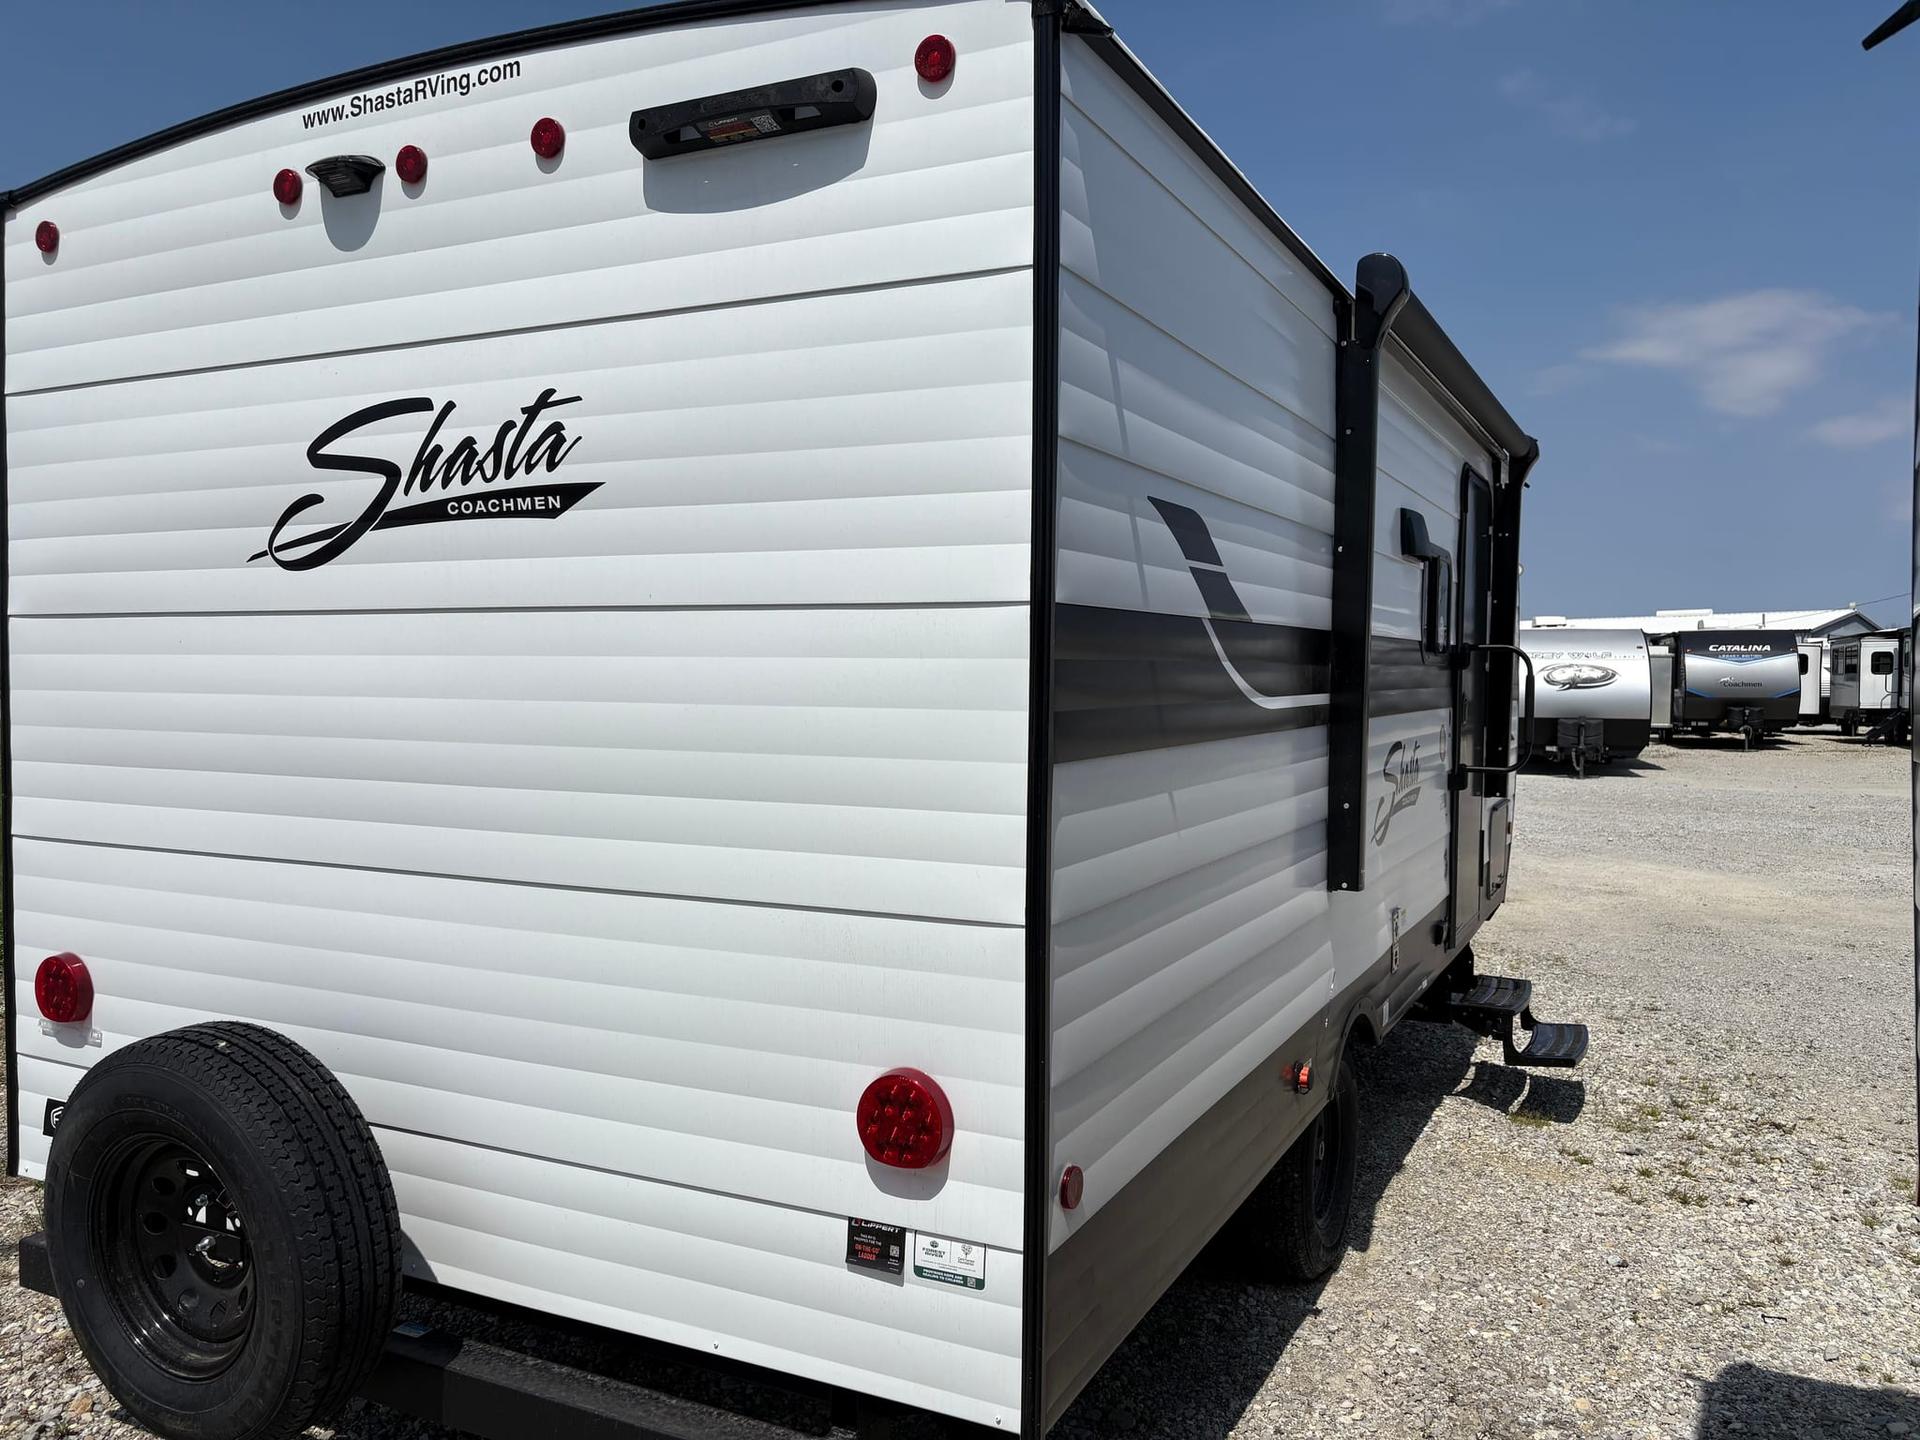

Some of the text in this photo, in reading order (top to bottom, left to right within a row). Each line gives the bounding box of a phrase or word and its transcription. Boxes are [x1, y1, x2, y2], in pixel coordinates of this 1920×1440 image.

[302, 60, 521, 129] www.ShastaRVing.com
[268, 388, 583, 571] Shasta
[446, 495, 562, 515] COACHMEN
[1708, 644, 1771, 652] CATALINA
